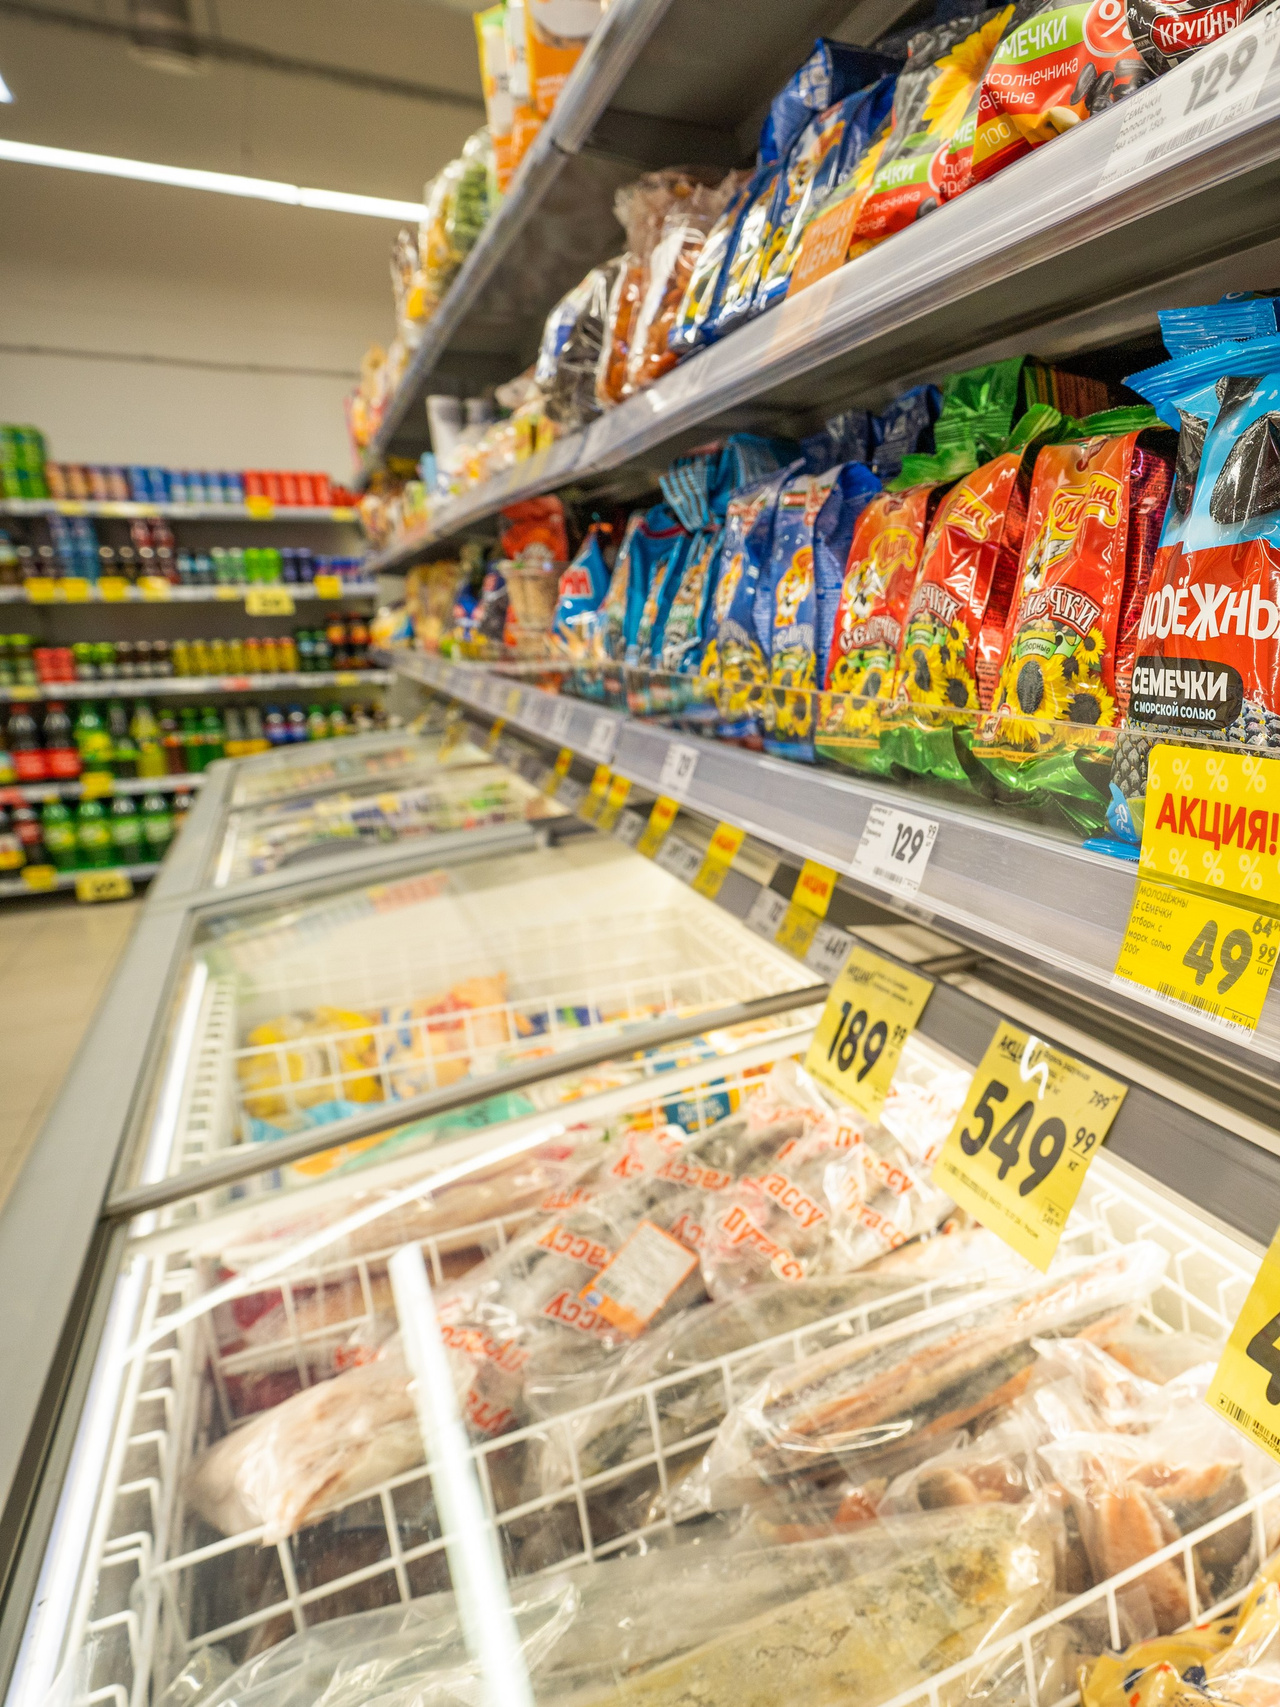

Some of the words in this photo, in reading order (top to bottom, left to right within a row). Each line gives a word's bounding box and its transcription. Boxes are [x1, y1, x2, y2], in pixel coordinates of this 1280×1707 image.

[994, 15, 1067, 60] МЕЧКИ
[1183, 34, 1259, 117] 129
[980, 121, 1012, 148] 100
[1131, 666, 1229, 702] СЕМЕЧКИ
[1139, 701, 1179, 718] МОРСКОЙ
[1180, 705, 1217, 721] СОЛЬЮ
[1154, 791, 1280, 856] АКЦИЯ!
[891, 822, 924, 864] 129
[1140, 901, 1173, 920] СЕМЕЧКИ
[1252, 915, 1273, 939] 64
[1182, 919, 1254, 996] 49
[1258, 943, 1277, 963] 99
[827, 1000, 888, 1083] 189
[892, 1024, 907, 1045] 99
[960, 1079, 1067, 1197] 549
[1072, 1126, 1096, 1154] 99
